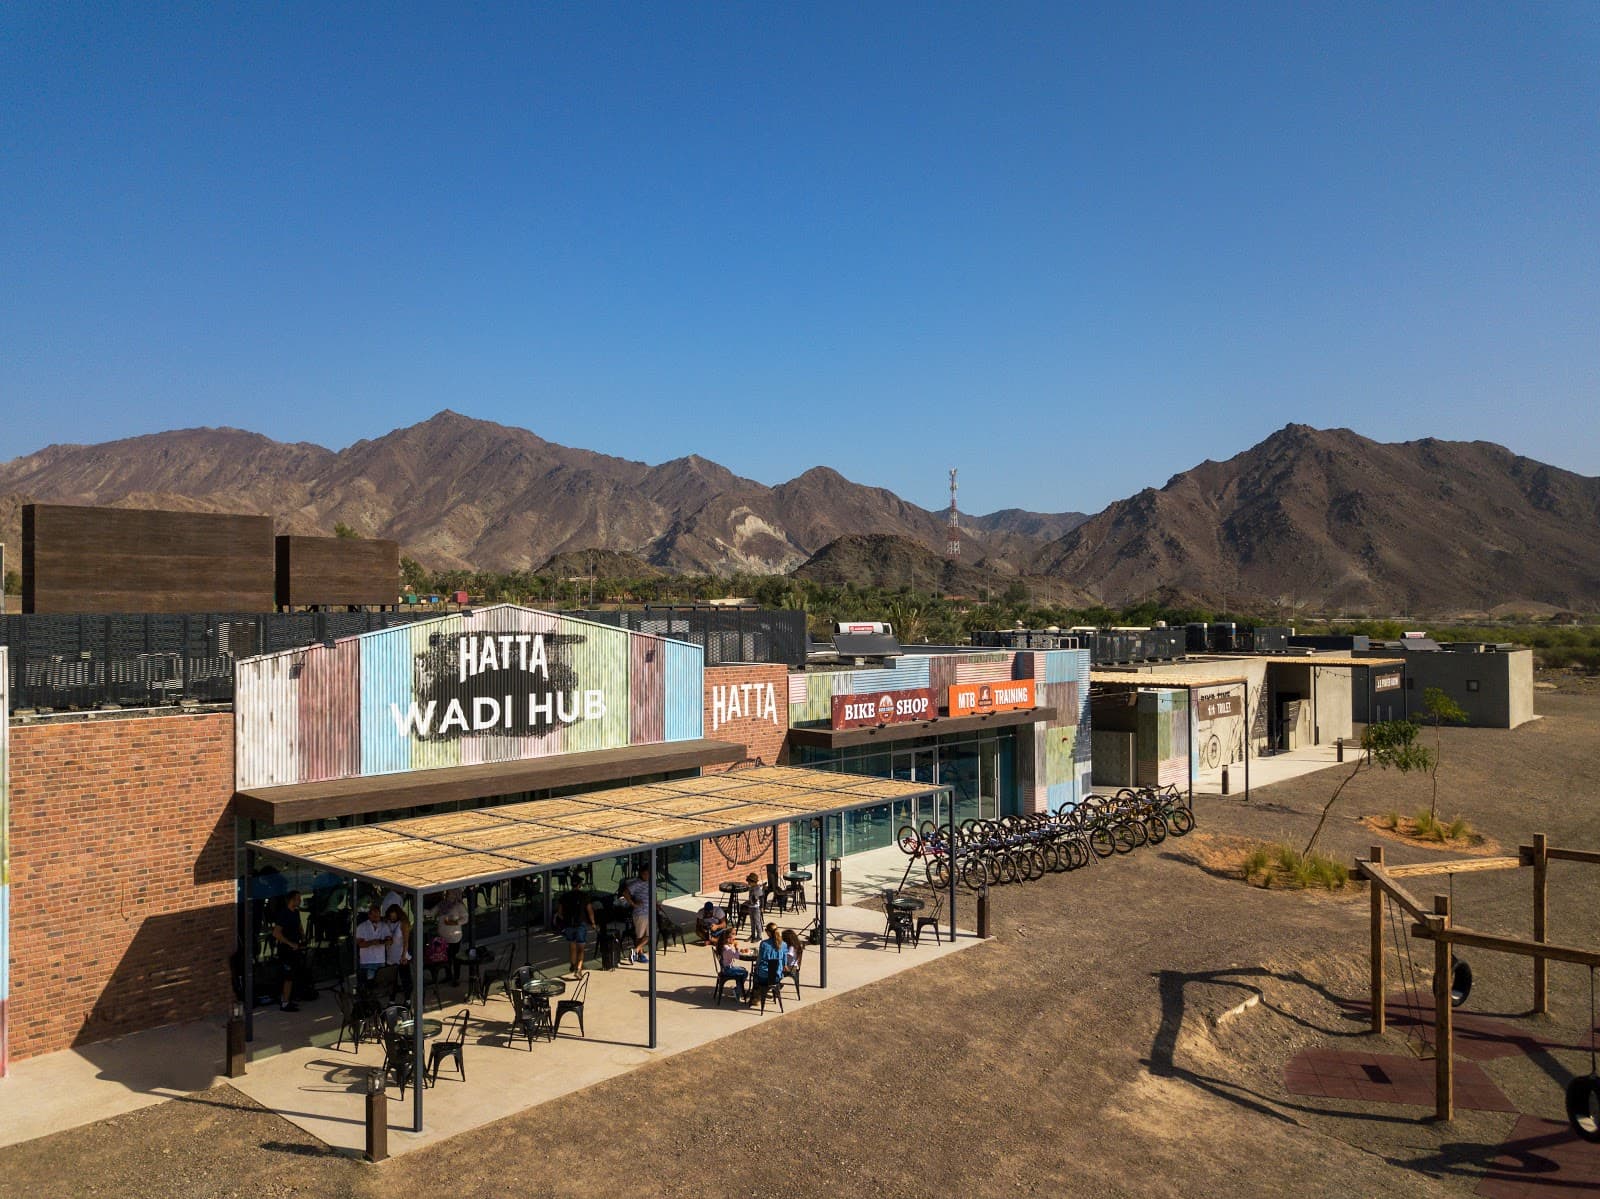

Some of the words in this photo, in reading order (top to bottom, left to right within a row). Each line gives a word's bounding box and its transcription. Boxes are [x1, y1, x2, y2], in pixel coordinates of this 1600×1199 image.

[459, 634, 549, 683] HATTA
[389, 694, 513, 737] WADI
[528, 689, 606, 725] HUB
[712, 683, 778, 731] HATTA
[844, 702, 876, 721] BIKE
[896, 697, 929, 715] SHOP
[958, 692, 976, 709] MTB
[994, 687, 1028, 705] TRAINING
[1217, 701, 1232, 714] TOILET
